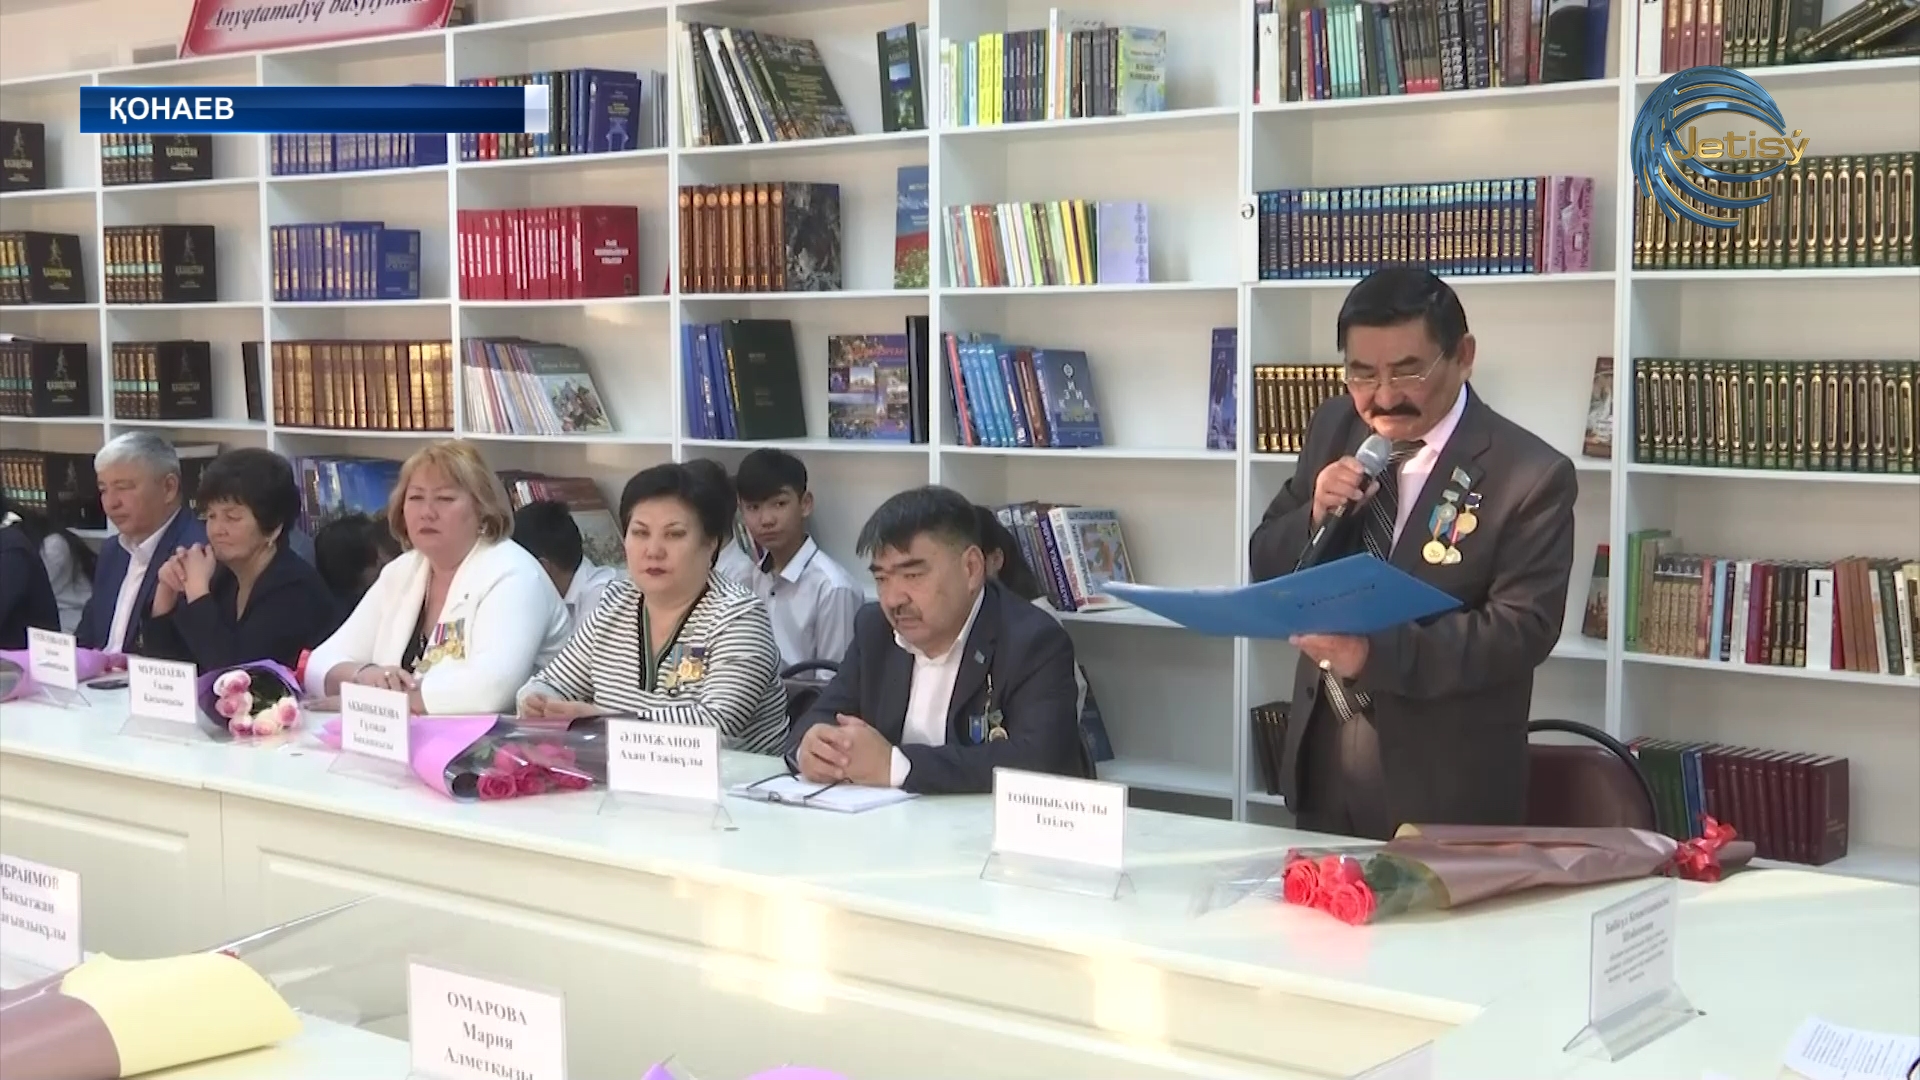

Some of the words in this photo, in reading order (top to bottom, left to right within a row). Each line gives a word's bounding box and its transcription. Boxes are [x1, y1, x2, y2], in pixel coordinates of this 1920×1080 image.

[1814, 578, 1831, 598] Г
[447, 991, 528, 1026] ОМАРОВА
[462, 1020, 513, 1050] Мария
